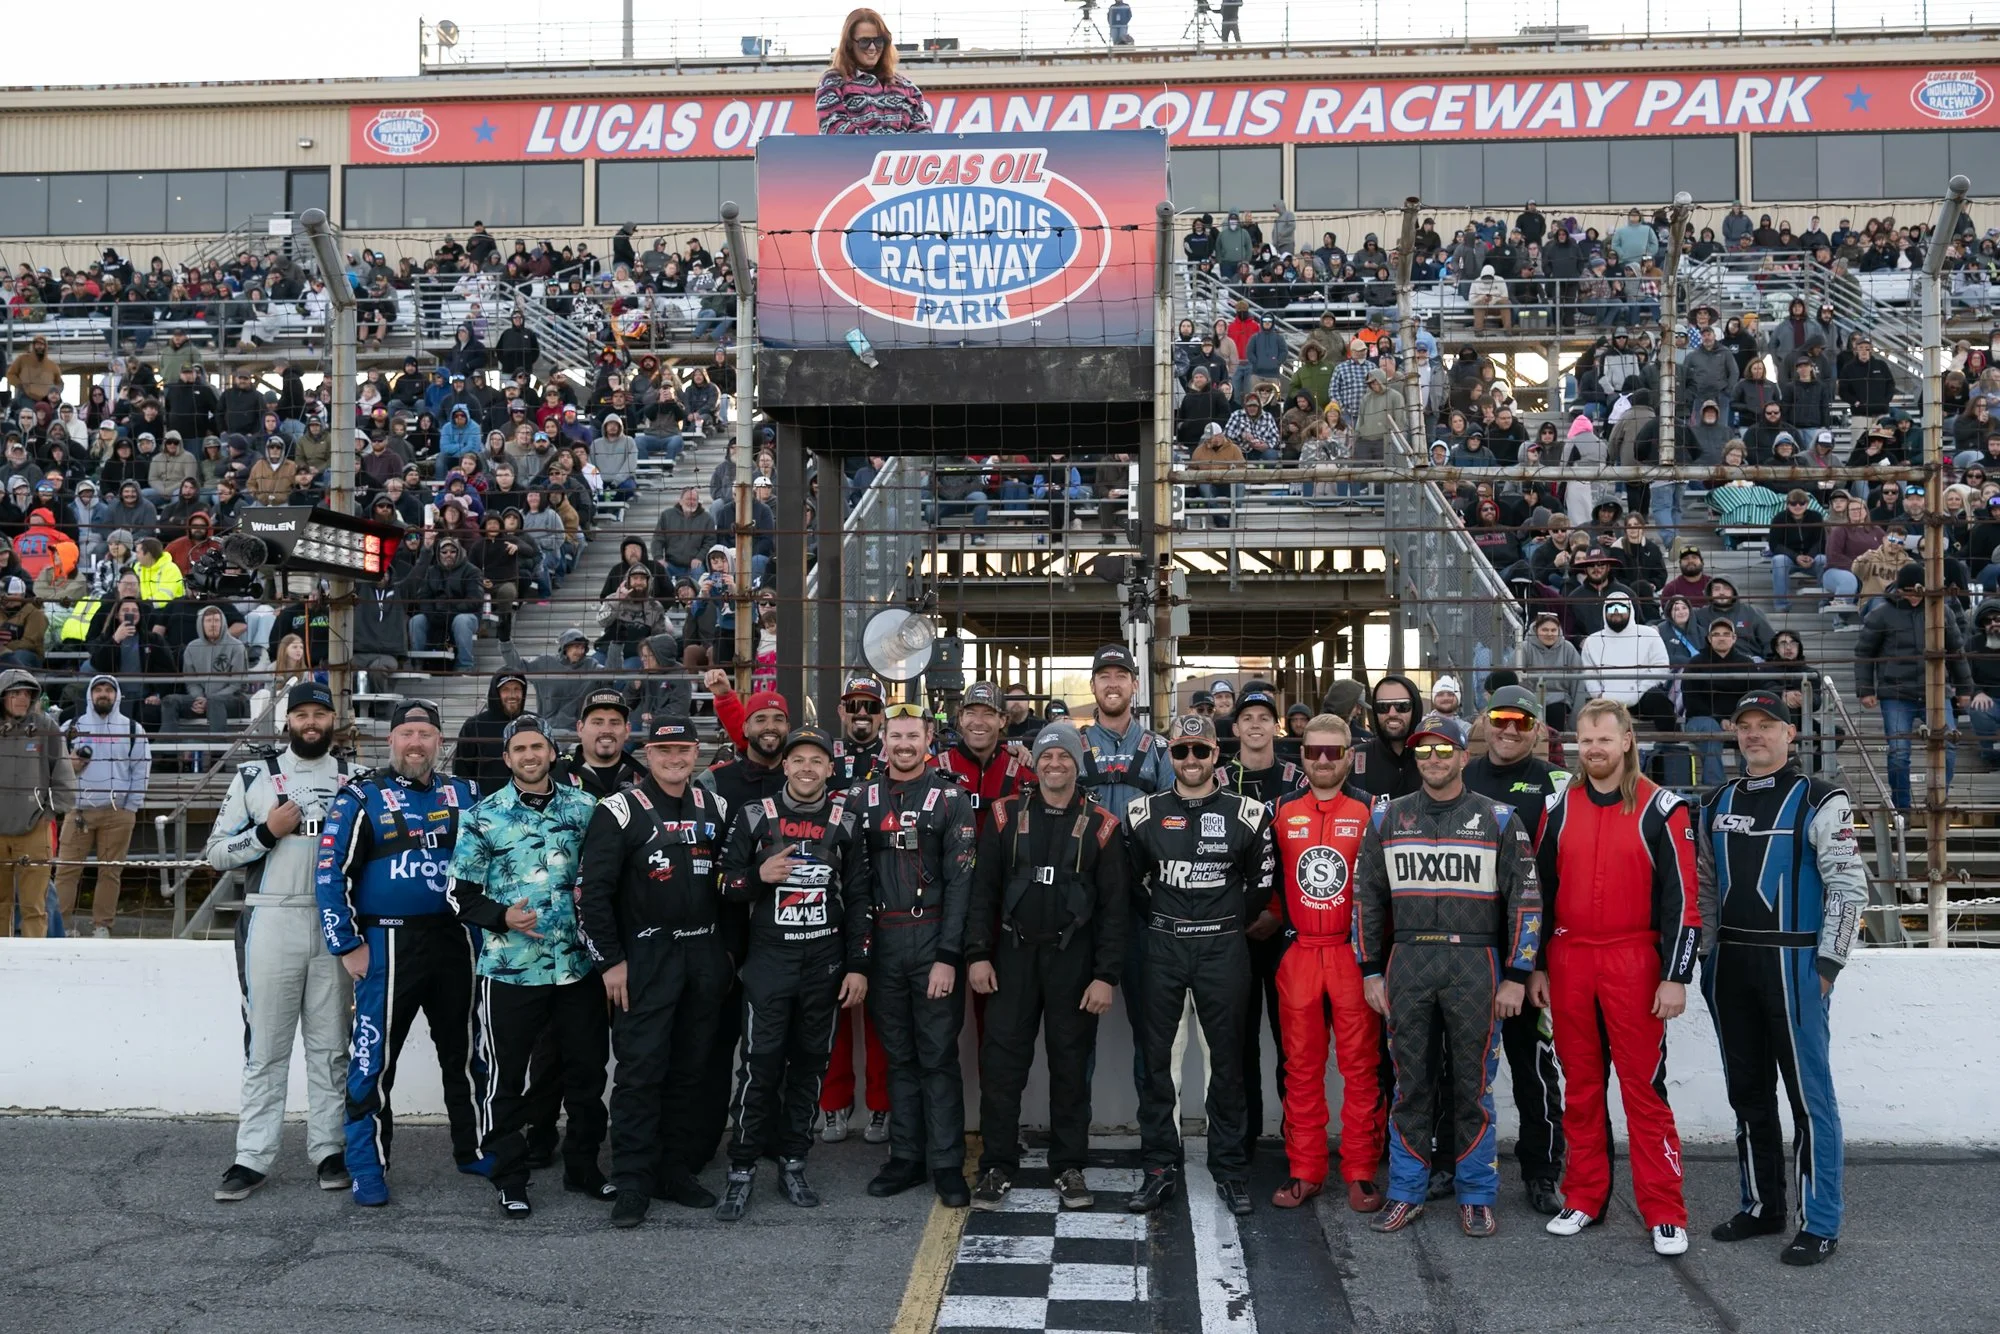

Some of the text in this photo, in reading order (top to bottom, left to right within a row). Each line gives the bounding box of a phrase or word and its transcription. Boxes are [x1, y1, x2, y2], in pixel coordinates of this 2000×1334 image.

[1927, 72, 1975, 81] LUCAS OIL
[1927, 82, 1978, 97] INDIANAPOLIS
[1929, 96, 1976, 109] RACEWAY
[380, 110, 422, 119] LUCAS OIL
[525, 102, 704, 153] LUCAS
[711, 99, 797, 151] OIL
[1295, 79, 1631, 136] RACEWAY
[1634, 76, 1824, 128] PARK
[380, 132, 422, 146] RACEWAY
[871, 152, 1044, 186] LUCAS OIL
[871, 192, 1051, 242] INDIANAPOLIS
[880, 243, 1044, 290] RACEWAY
[916, 296, 1008, 325] PARK
[251, 520, 296, 532] WHELEN
[592, 693, 621, 704] MIDNIGHT
[1203, 814, 1223, 825] HIGH
[1712, 814, 1755, 833] KSR
[1203, 823, 1226, 834] ROCK
[1197, 840, 1228, 855] Sugarlands
[1193, 861, 1233, 871] HUFFMAN
[1300, 849, 1344, 870] CIRCLE
[1313, 863, 1329, 883] S
[1394, 852, 1482, 884] DIXXON
[1189, 870, 1220, 882] RACING
[1300, 878, 1343, 897] RANCH
[1300, 894, 1346, 911] Canton, KS
[322, 907, 341, 949] Kroger
[672, 927, 709, 940] Frankie
[784, 927, 832, 941] BRAD DEBERTI
[1177, 924, 1221, 933] HUFFMAN
[356, 1014, 382, 1077] Kroger
